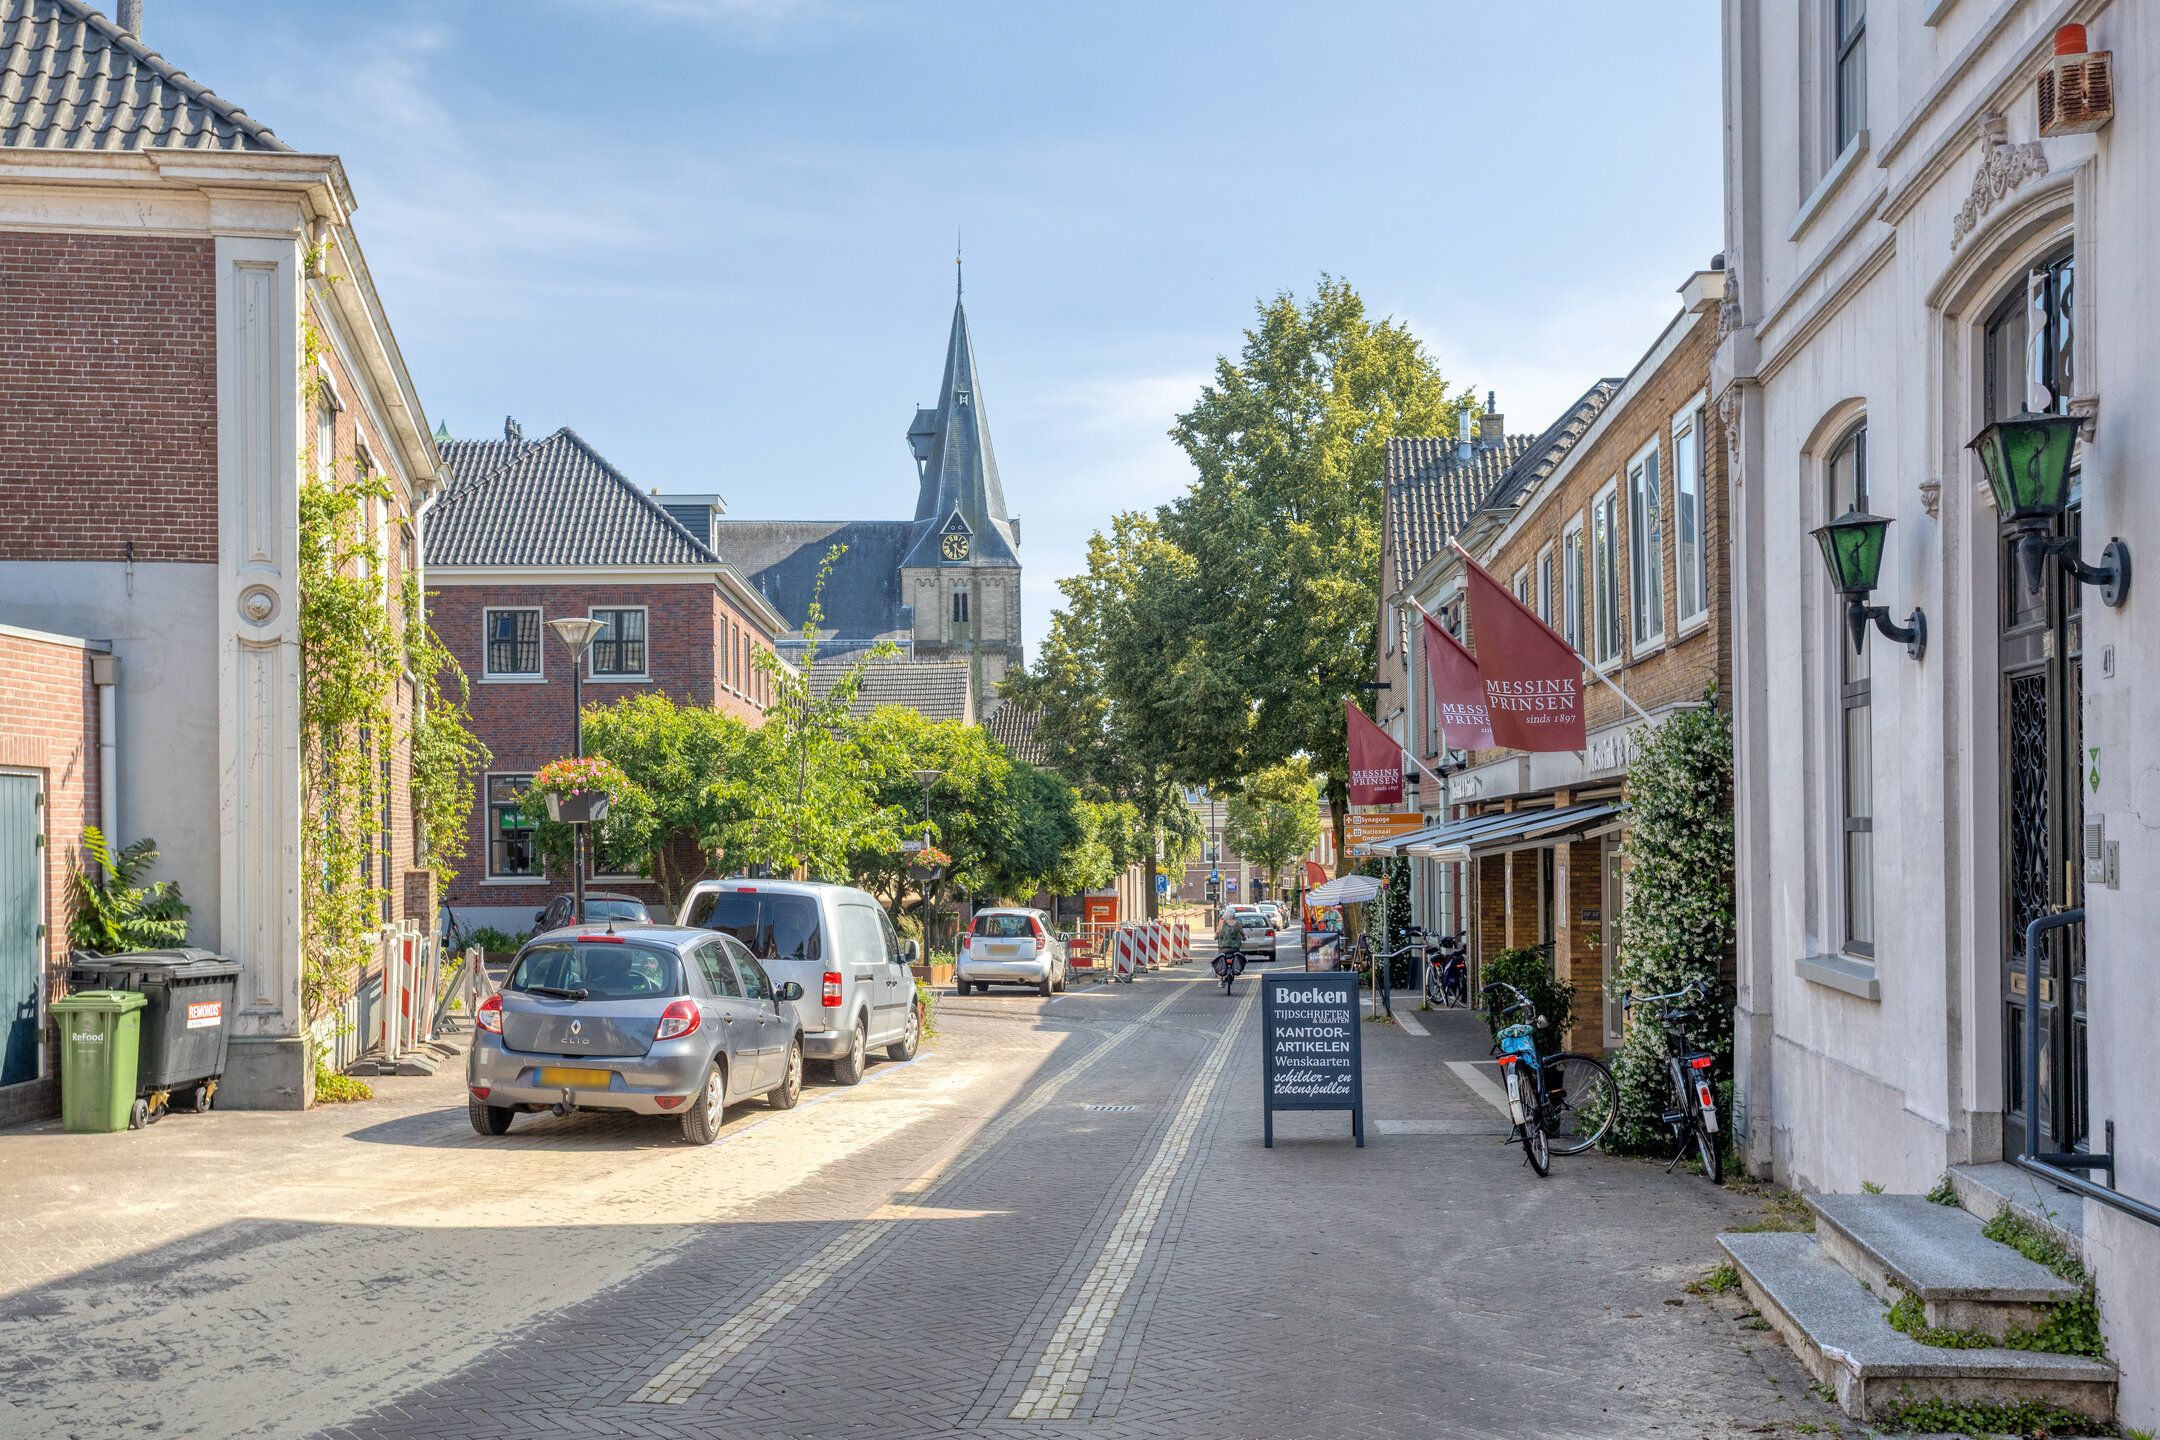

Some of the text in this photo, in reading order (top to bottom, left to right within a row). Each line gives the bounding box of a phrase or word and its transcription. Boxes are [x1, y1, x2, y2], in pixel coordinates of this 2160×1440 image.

[2103, 649, 2111, 674] 41
[1486, 679, 1576, 694] MESSINK
[1442, 703, 1488, 714] MESSI
[1489, 696, 1575, 711] PRINSEN
[1444, 714, 1491, 726] PRINS
[1525, 714, 1576, 724] sinds 1897
[1352, 768, 1399, 778] MESSINK
[1353, 777, 1398, 786] PRINSEN
[1361, 816, 1390, 824] Synagoge
[1276, 987, 1347, 1004] Boeken
[1274, 1009, 1350, 1020] TIJDSCHRIFTEN
[72, 1032, 104, 1041] ReFood
[1275, 1041, 1350, 1052] ARTIKELEN
[1275, 1055, 1350, 1067] Wenskaarten
[1337, 1073, 1352, 1083] en
[1273, 1081, 1351, 1098] tekenspullen
